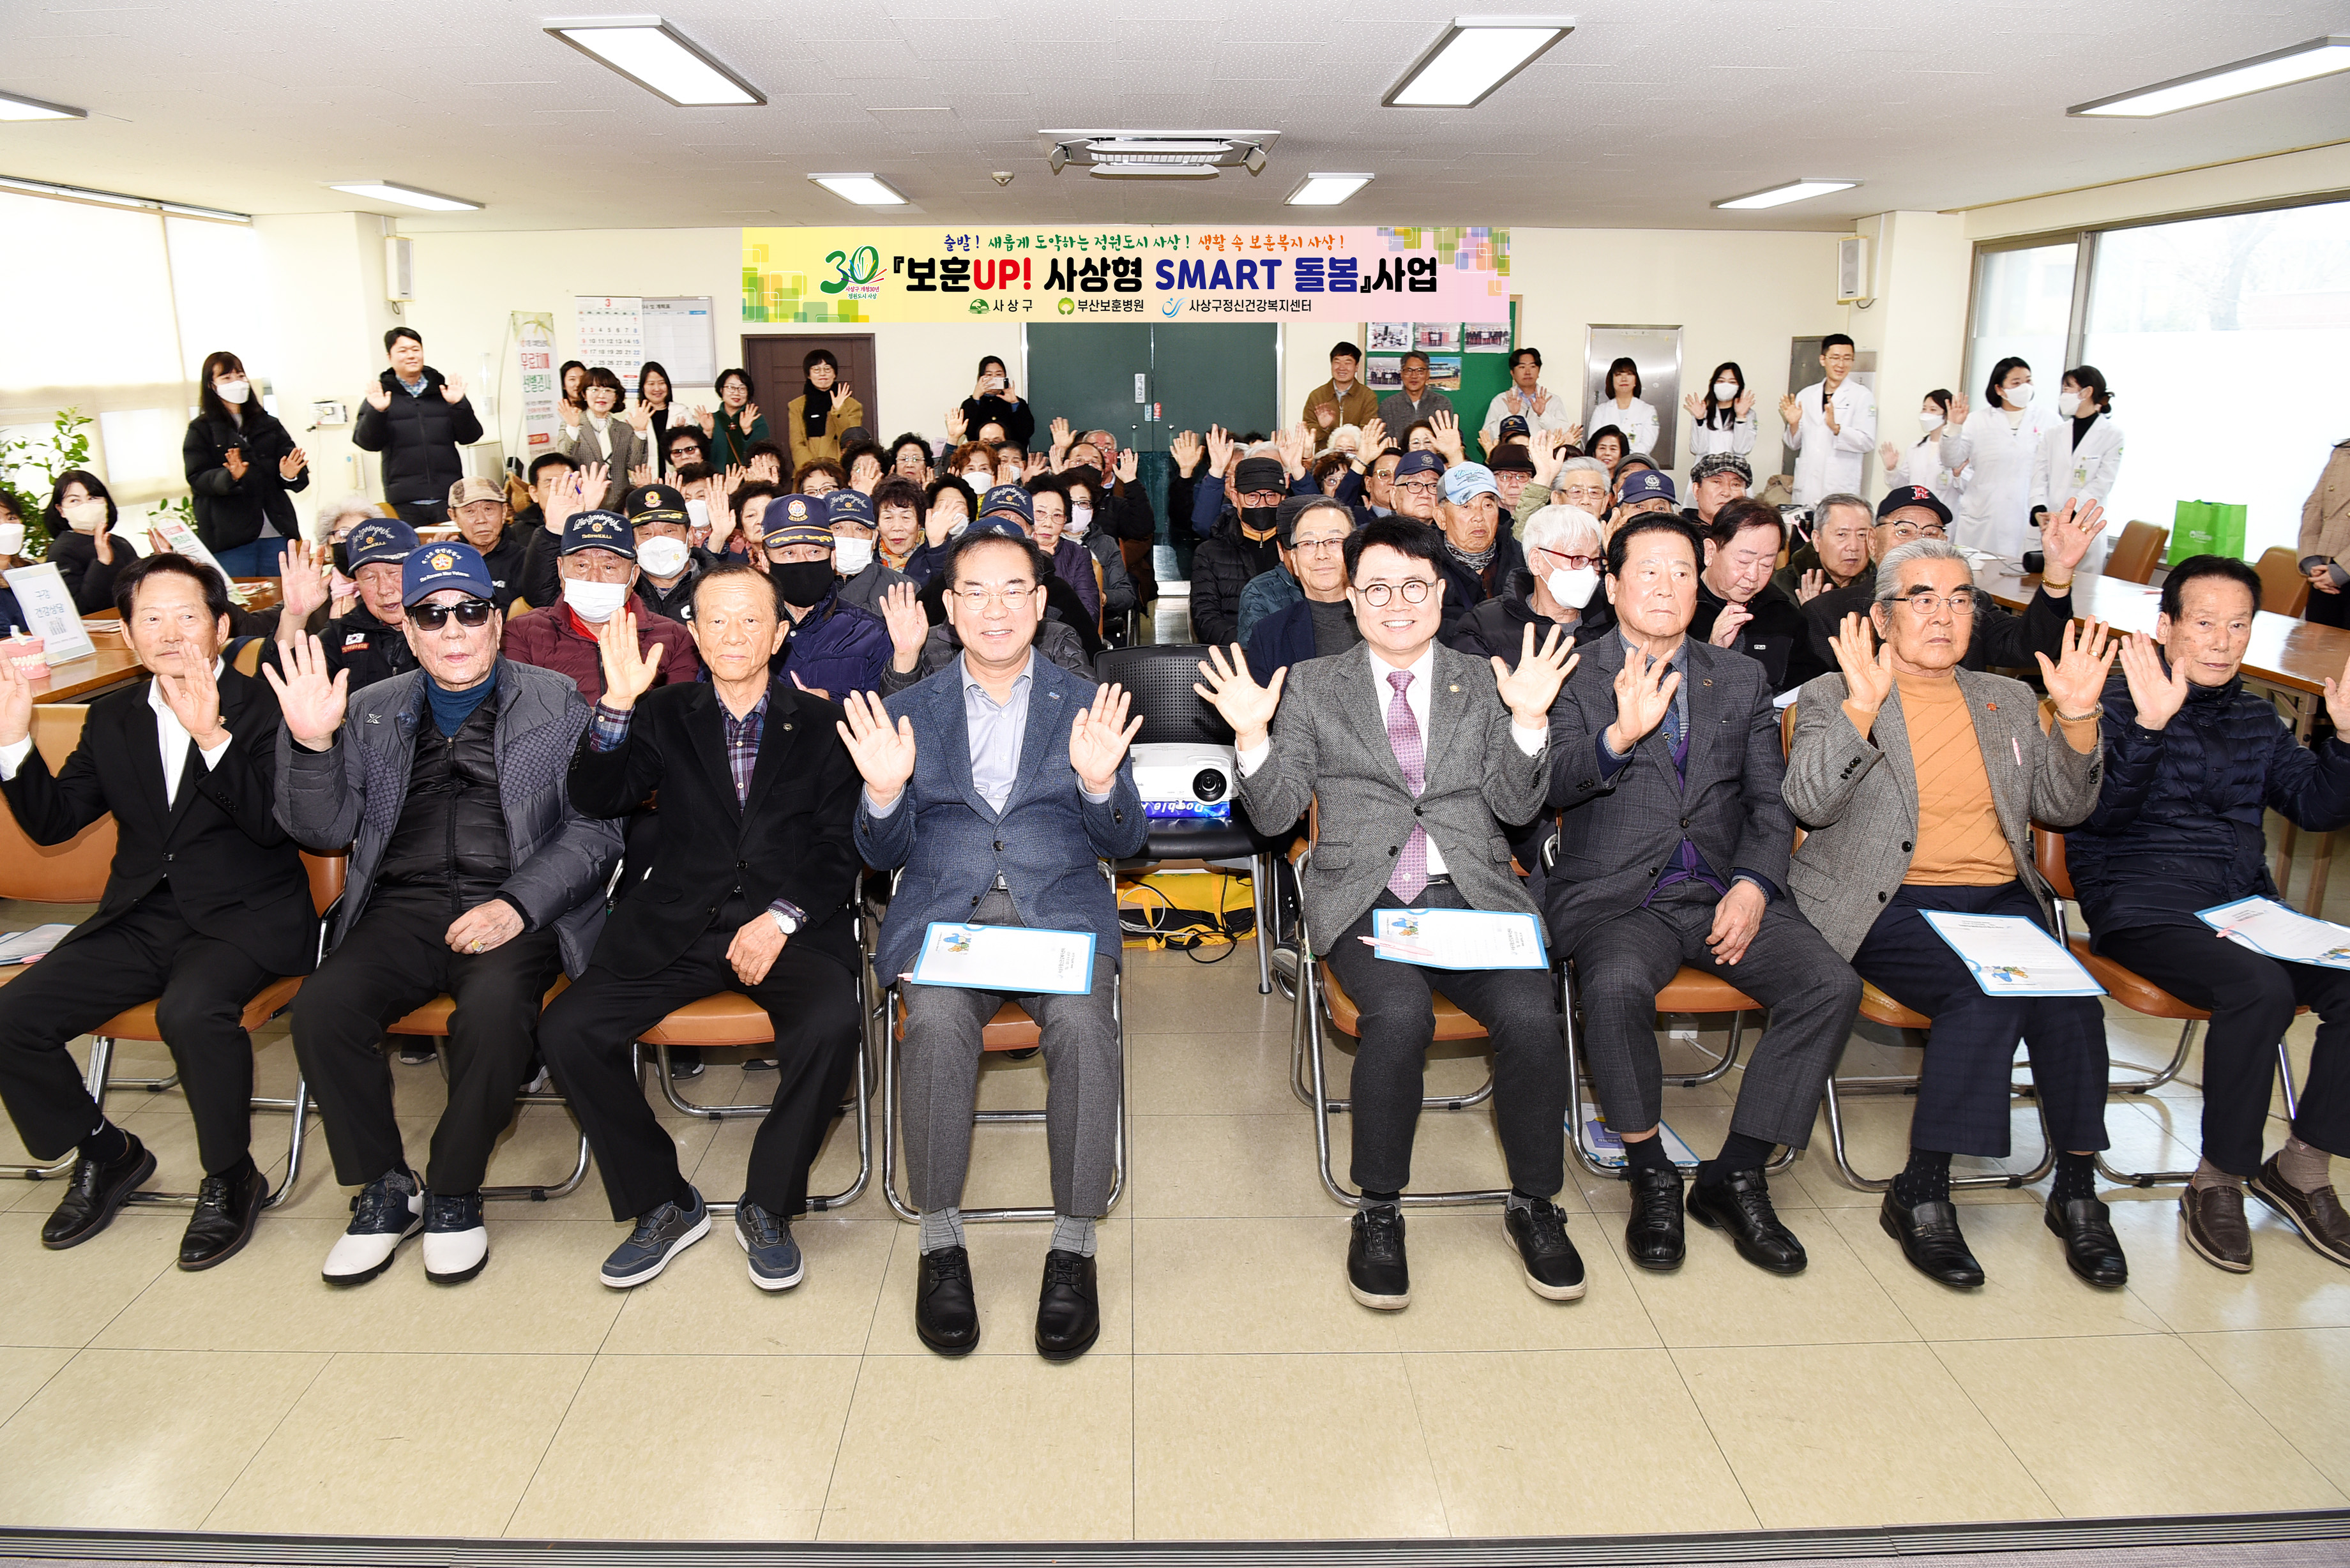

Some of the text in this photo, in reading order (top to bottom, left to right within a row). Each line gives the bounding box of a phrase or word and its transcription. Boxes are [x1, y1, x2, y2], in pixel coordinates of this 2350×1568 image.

[989, 234, 1029, 252] 새롭게
[1035, 234, 1089, 252] 도약하는
[1094, 234, 1148, 251] 정원도시
[1199, 234, 1226, 252] 생활
[1231, 234, 1243, 252] 속
[1250, 234, 1302, 252] 보훈복지
[1044, 257, 1142, 292] 사상형
[1156, 259, 1282, 290] SMART
[605, 299, 610, 307] 3
[1078, 299, 1143, 312] 부산보훈병원
[1189, 299, 1311, 312] 사상구정신건강복지센터
[34, 589, 50, 600] 구강
[34, 603, 64, 618] 건강상담
